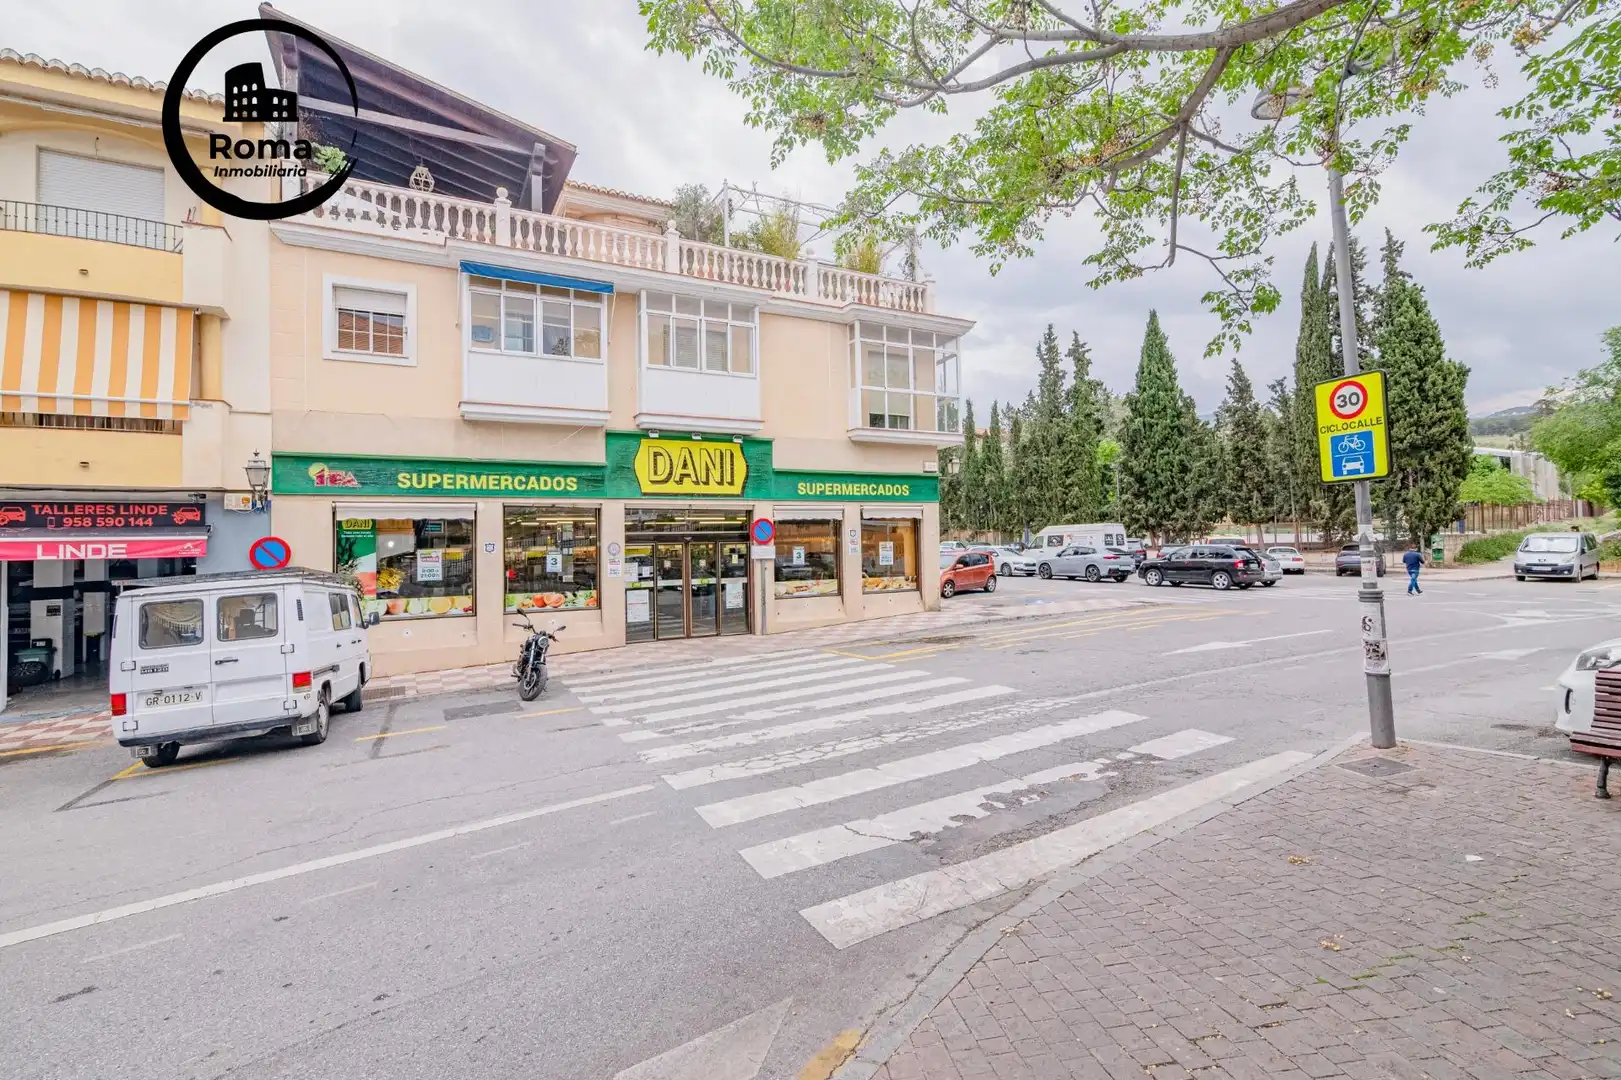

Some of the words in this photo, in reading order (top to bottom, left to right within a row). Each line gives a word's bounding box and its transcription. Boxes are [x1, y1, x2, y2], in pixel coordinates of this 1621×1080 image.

[1337, 391, 1360, 409] 30
[1319, 416, 1384, 434] CICLOCALLE
[647, 446, 735, 486] DANI
[397, 472, 578, 491] SUPERMERCADOS
[797, 482, 910, 497] SUPERMERCADOS
[31, 504, 116, 515] TALLERES
[119, 504, 168, 515] LINDE
[63, 517, 92, 527] 958
[96, 517, 125, 527] 590
[129, 517, 153, 527] 144
[345, 519, 371, 528] DANI
[36, 543, 128, 560] LINDE
[550, 557, 558, 566] 3
[146, 692, 202, 706] GR-0112-V
